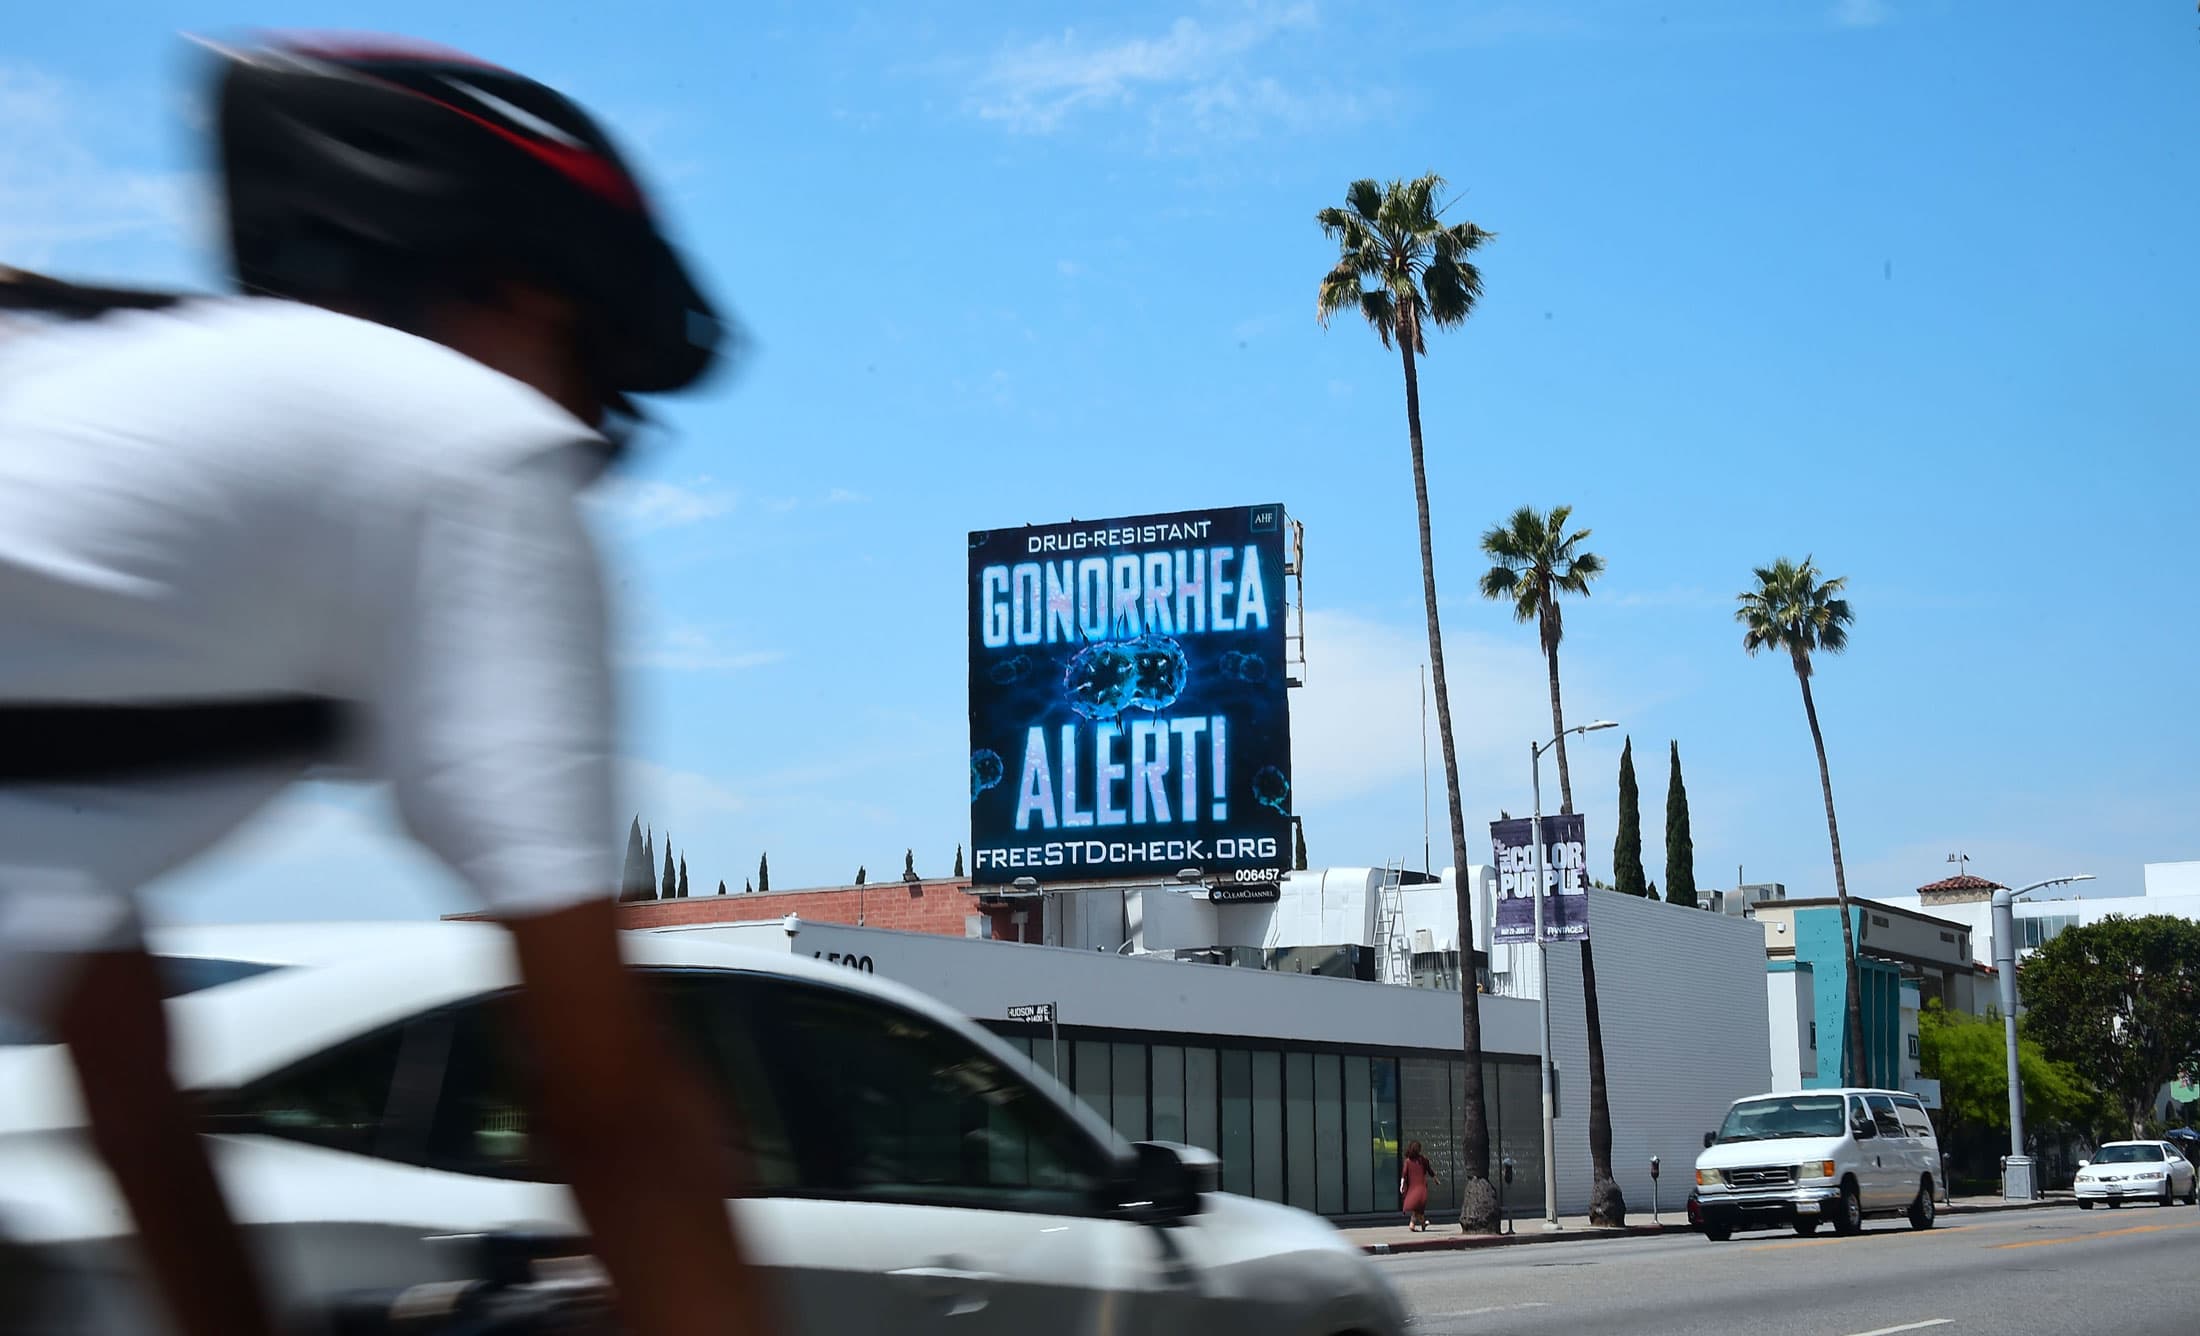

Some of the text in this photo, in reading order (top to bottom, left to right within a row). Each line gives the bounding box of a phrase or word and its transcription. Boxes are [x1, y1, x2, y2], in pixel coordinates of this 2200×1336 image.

[1254, 512, 1273, 524] AHF
[1028, 521, 1212, 553] DRUG-RESISTANT
[982, 545, 1268, 648] GONORRHEA
[1015, 716, 1228, 831] ALERT!
[1235, 868, 1280, 882] 006457
[1547, 925, 1584, 935] PANTAGES
[1008, 1006, 1034, 1017] HUDSON
